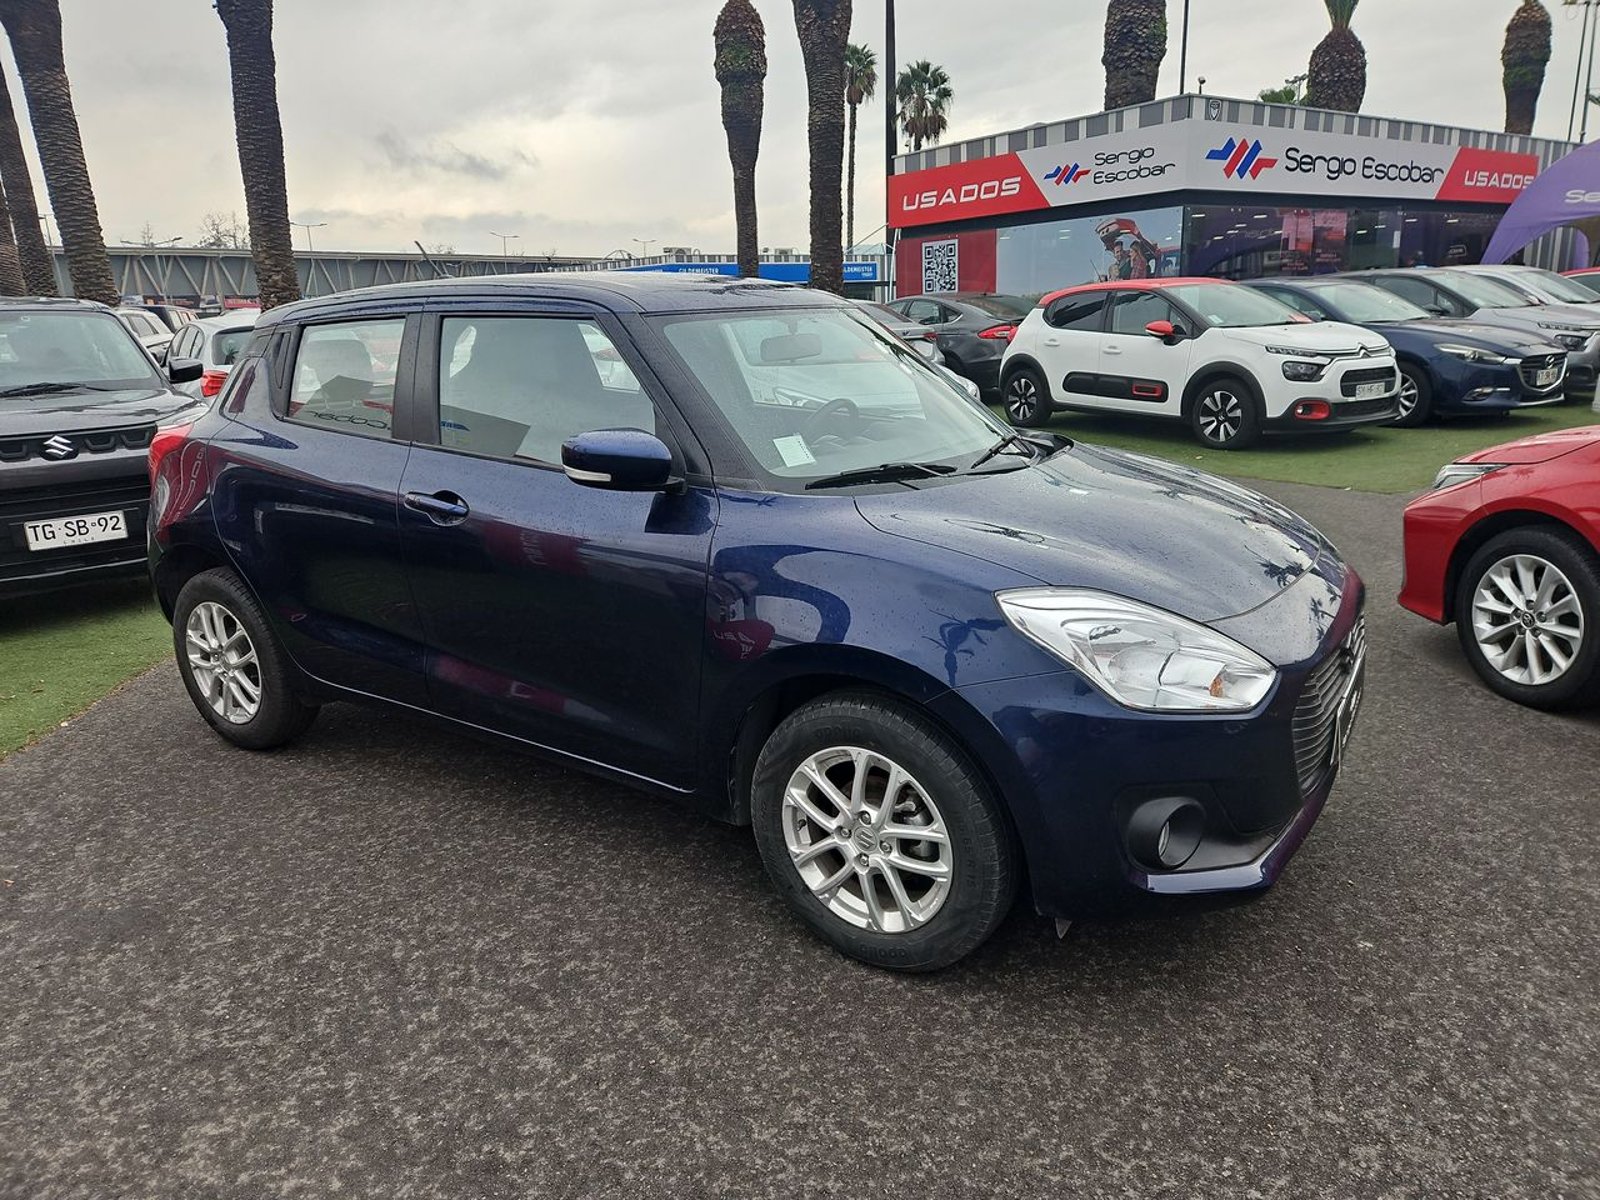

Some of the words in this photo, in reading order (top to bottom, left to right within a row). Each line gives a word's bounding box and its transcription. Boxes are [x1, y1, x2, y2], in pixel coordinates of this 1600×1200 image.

[1094, 147, 1155, 166] Sergio
[1285, 147, 1357, 181] Sergio
[1362, 156, 1444, 184] Escobar
[1093, 163, 1176, 185] Escobar
[1464, 169, 1535, 190] USADOS
[902, 176, 1021, 211] USADOS
